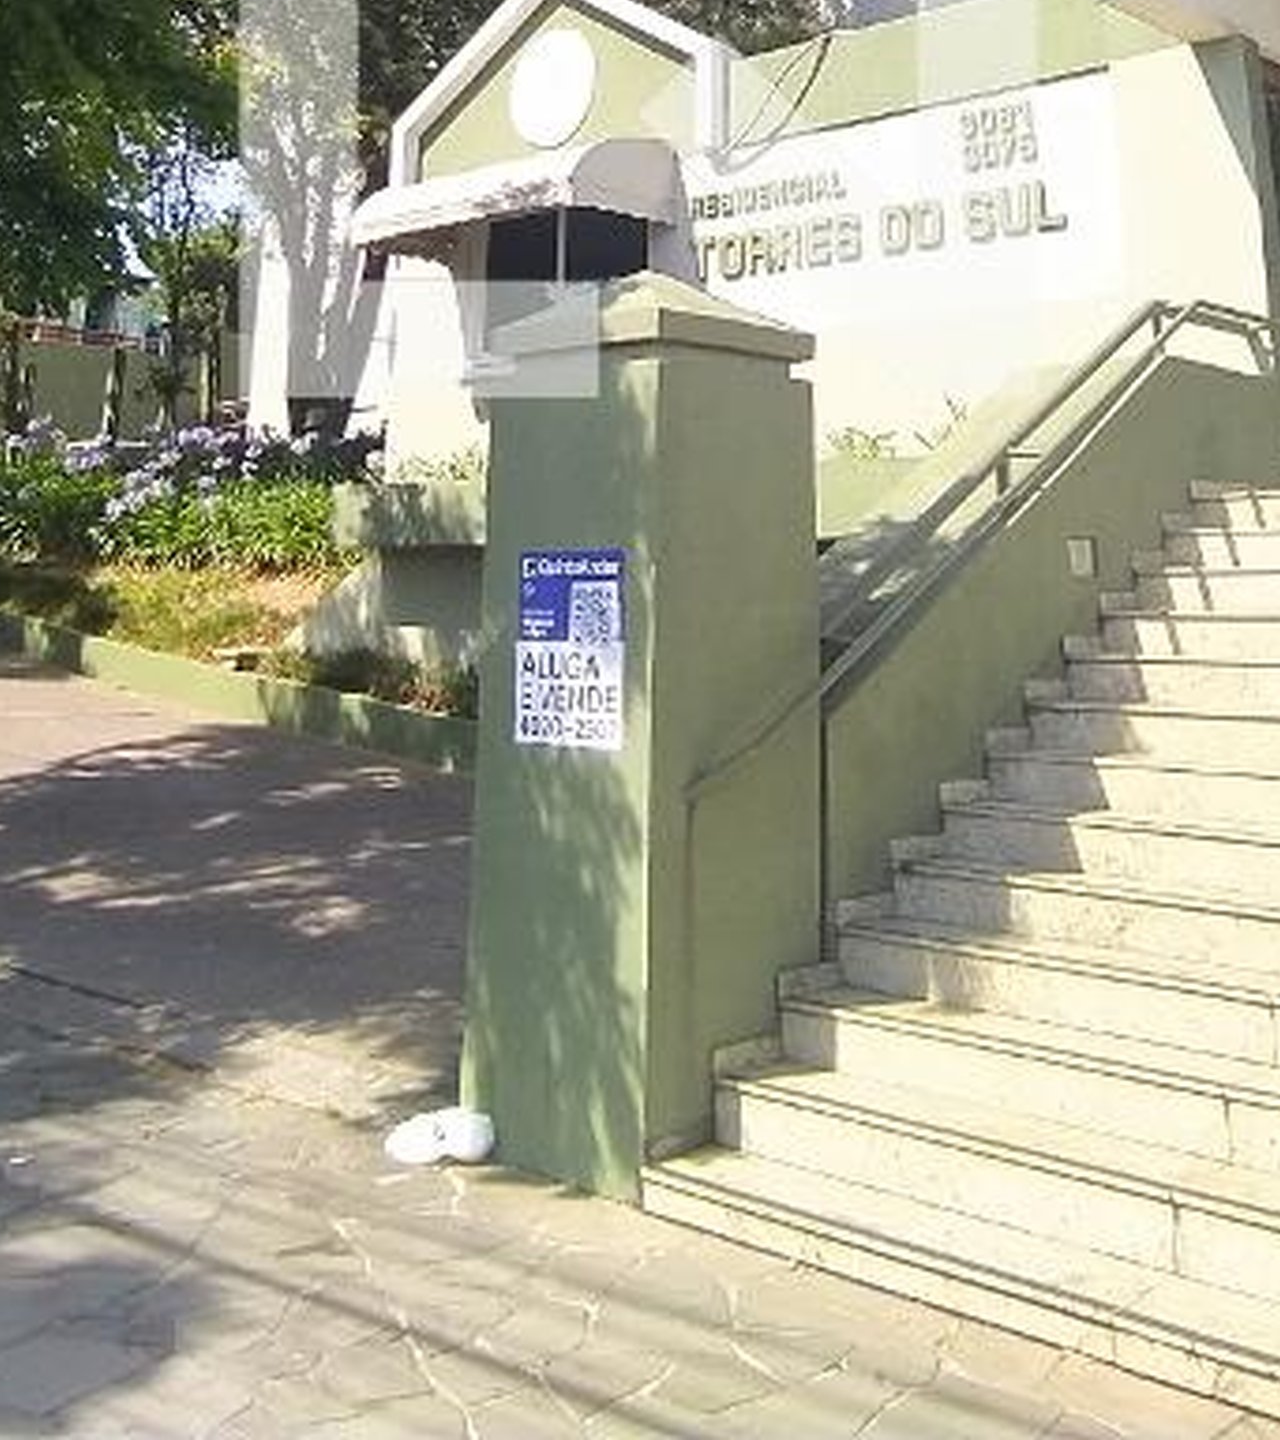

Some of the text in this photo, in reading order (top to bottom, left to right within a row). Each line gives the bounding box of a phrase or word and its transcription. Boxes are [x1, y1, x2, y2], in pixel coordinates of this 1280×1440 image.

[694, 179, 1069, 283] TORRES DO SUL
[523, 651, 601, 681] ALUGA
[538, 683, 618, 714] VENDE
